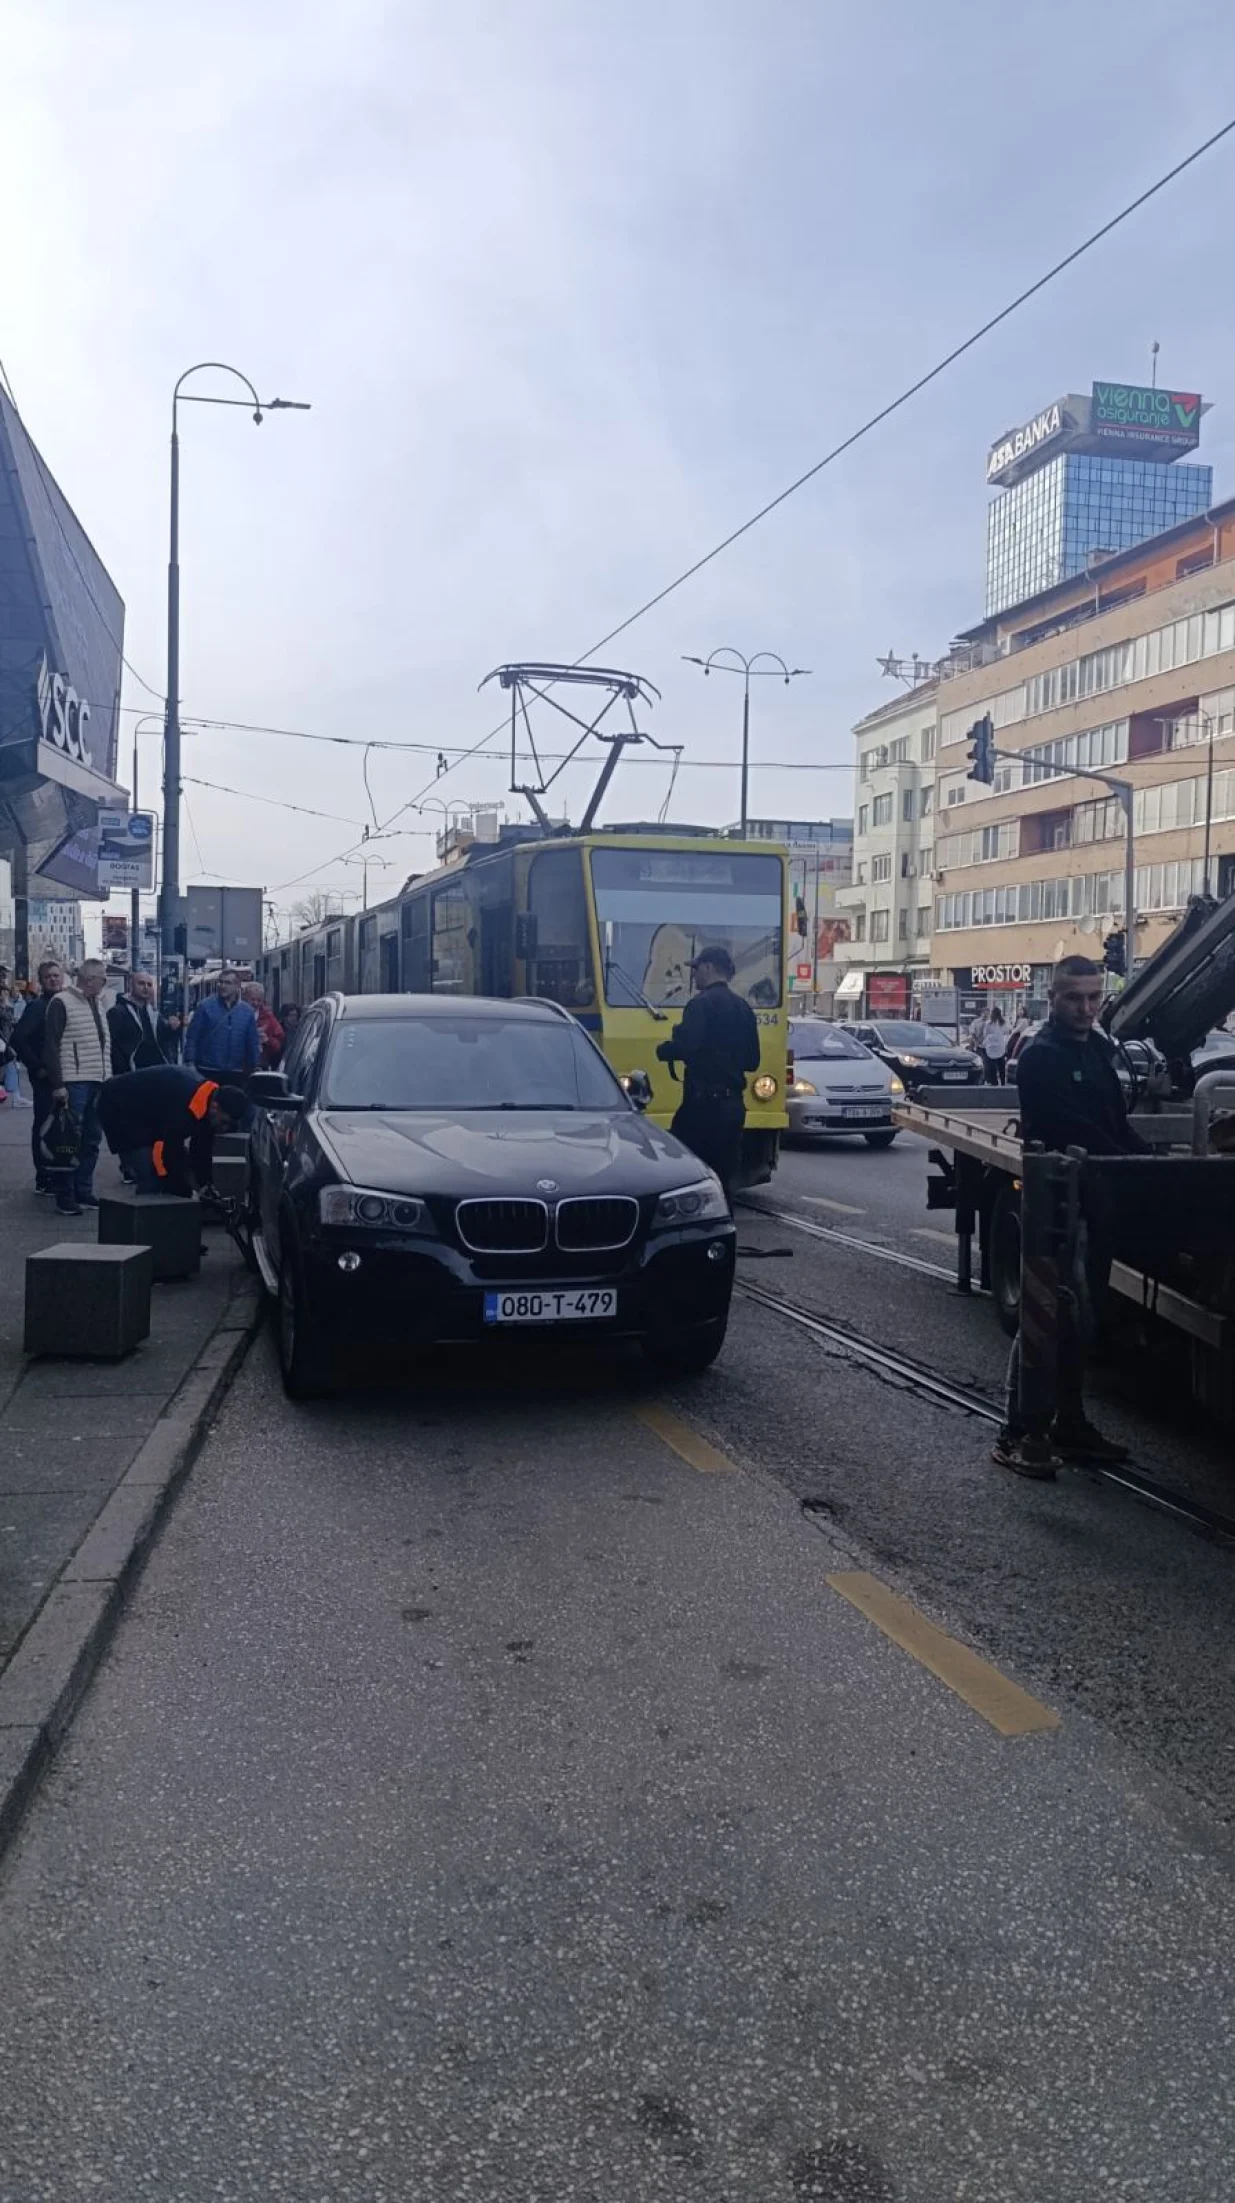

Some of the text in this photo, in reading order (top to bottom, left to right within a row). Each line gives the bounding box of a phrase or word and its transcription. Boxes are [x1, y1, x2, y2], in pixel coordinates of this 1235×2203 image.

[1096, 386, 1170, 412] vienna
[1097, 406, 1170, 426] osiguranje
[1014, 405, 1060, 454] BANKA
[1097, 429, 1126, 439] VIENNA
[1127, 431, 1170, 443] INSURANCE
[53, 672, 92, 767] SCC
[971, 964, 1031, 983] PROSTOR
[502, 1292, 613, 1317] 080-T-479
